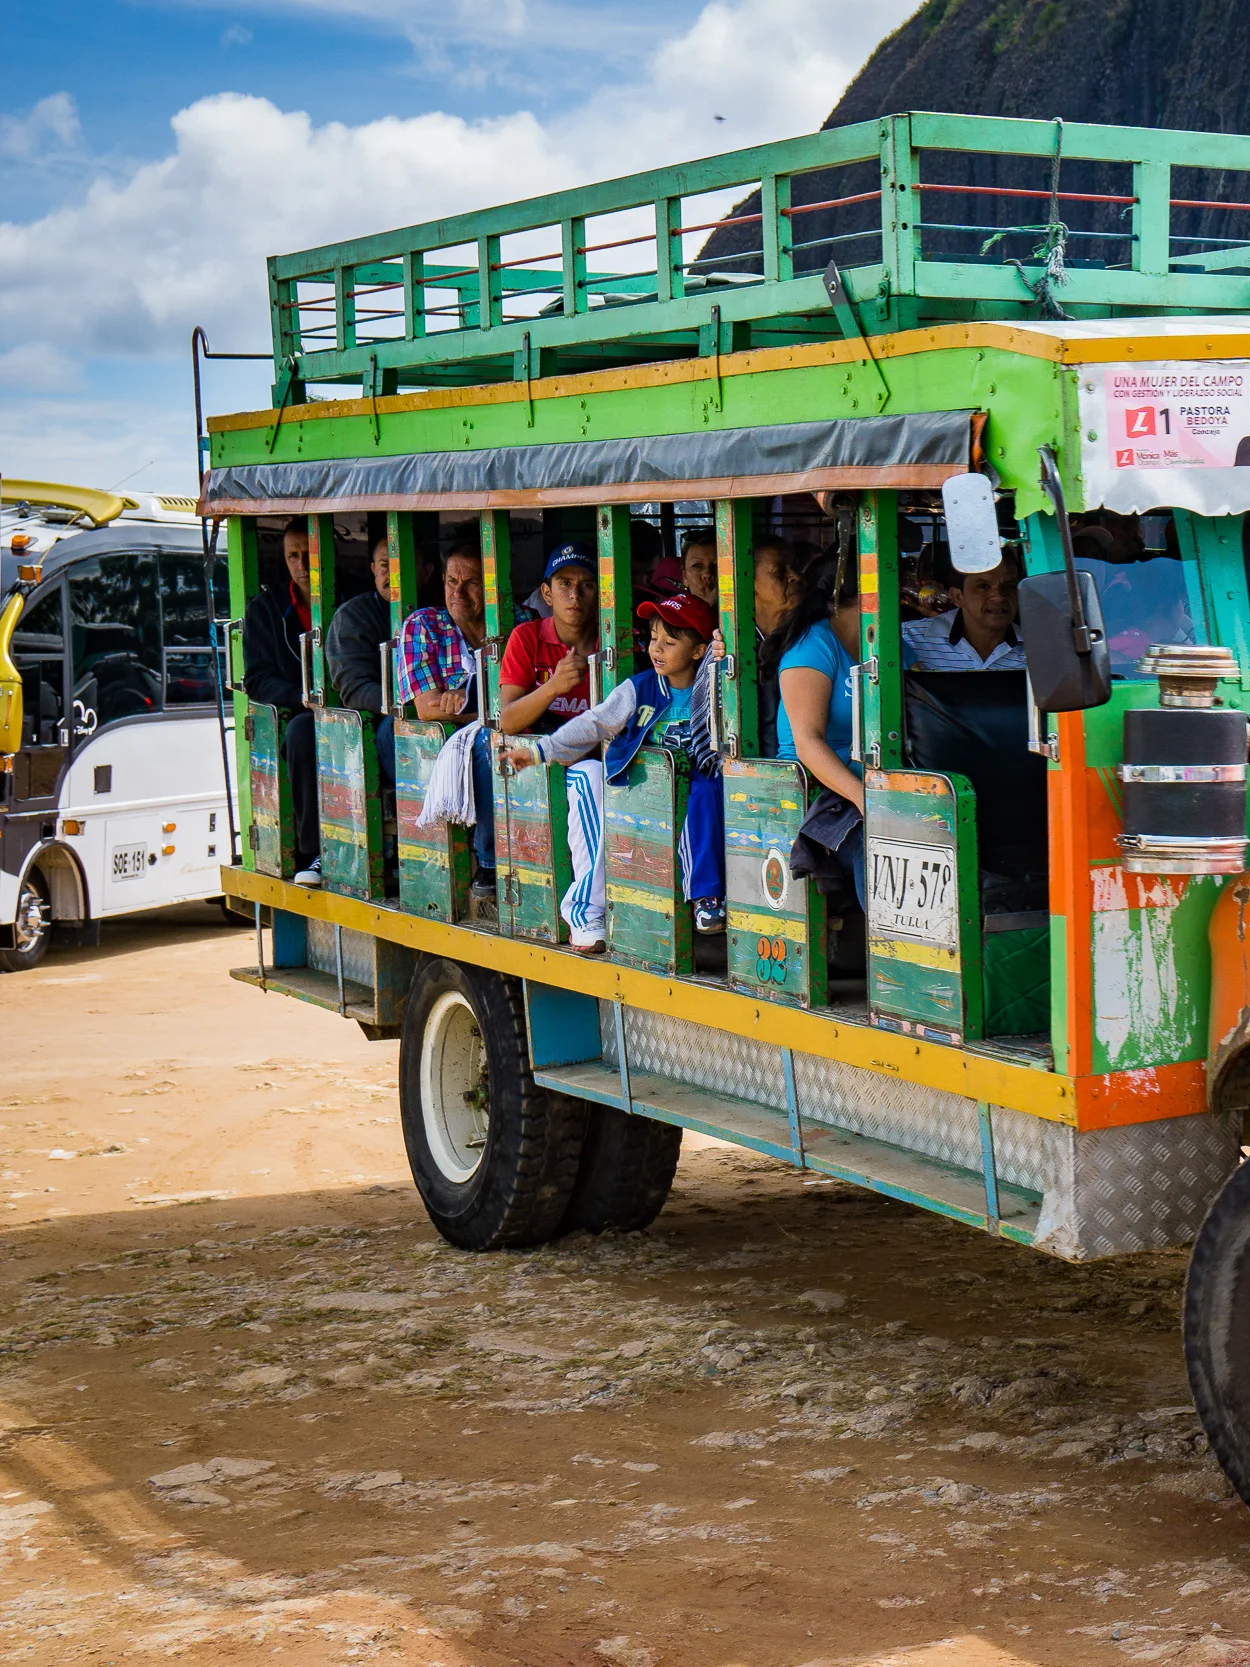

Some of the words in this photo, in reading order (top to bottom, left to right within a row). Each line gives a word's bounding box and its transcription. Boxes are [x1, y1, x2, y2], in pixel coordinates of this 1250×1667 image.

[1113, 376, 1137, 388] UNA
[1140, 376, 1177, 388] MUJER
[1180, 376, 1200, 387] DEL
[1203, 375, 1244, 387] CAMPO
[1113, 389, 1130, 398] CON
[1166, 389, 1172, 397] Y
[1172, 388, 1215, 397] LIDERAZGO
[1216, 388, 1244, 397] SOCIAL
[1180, 406, 1231, 416] PASTORA
[1159, 408, 1171, 435] 1
[1186, 416, 1229, 426] BEDOYA
